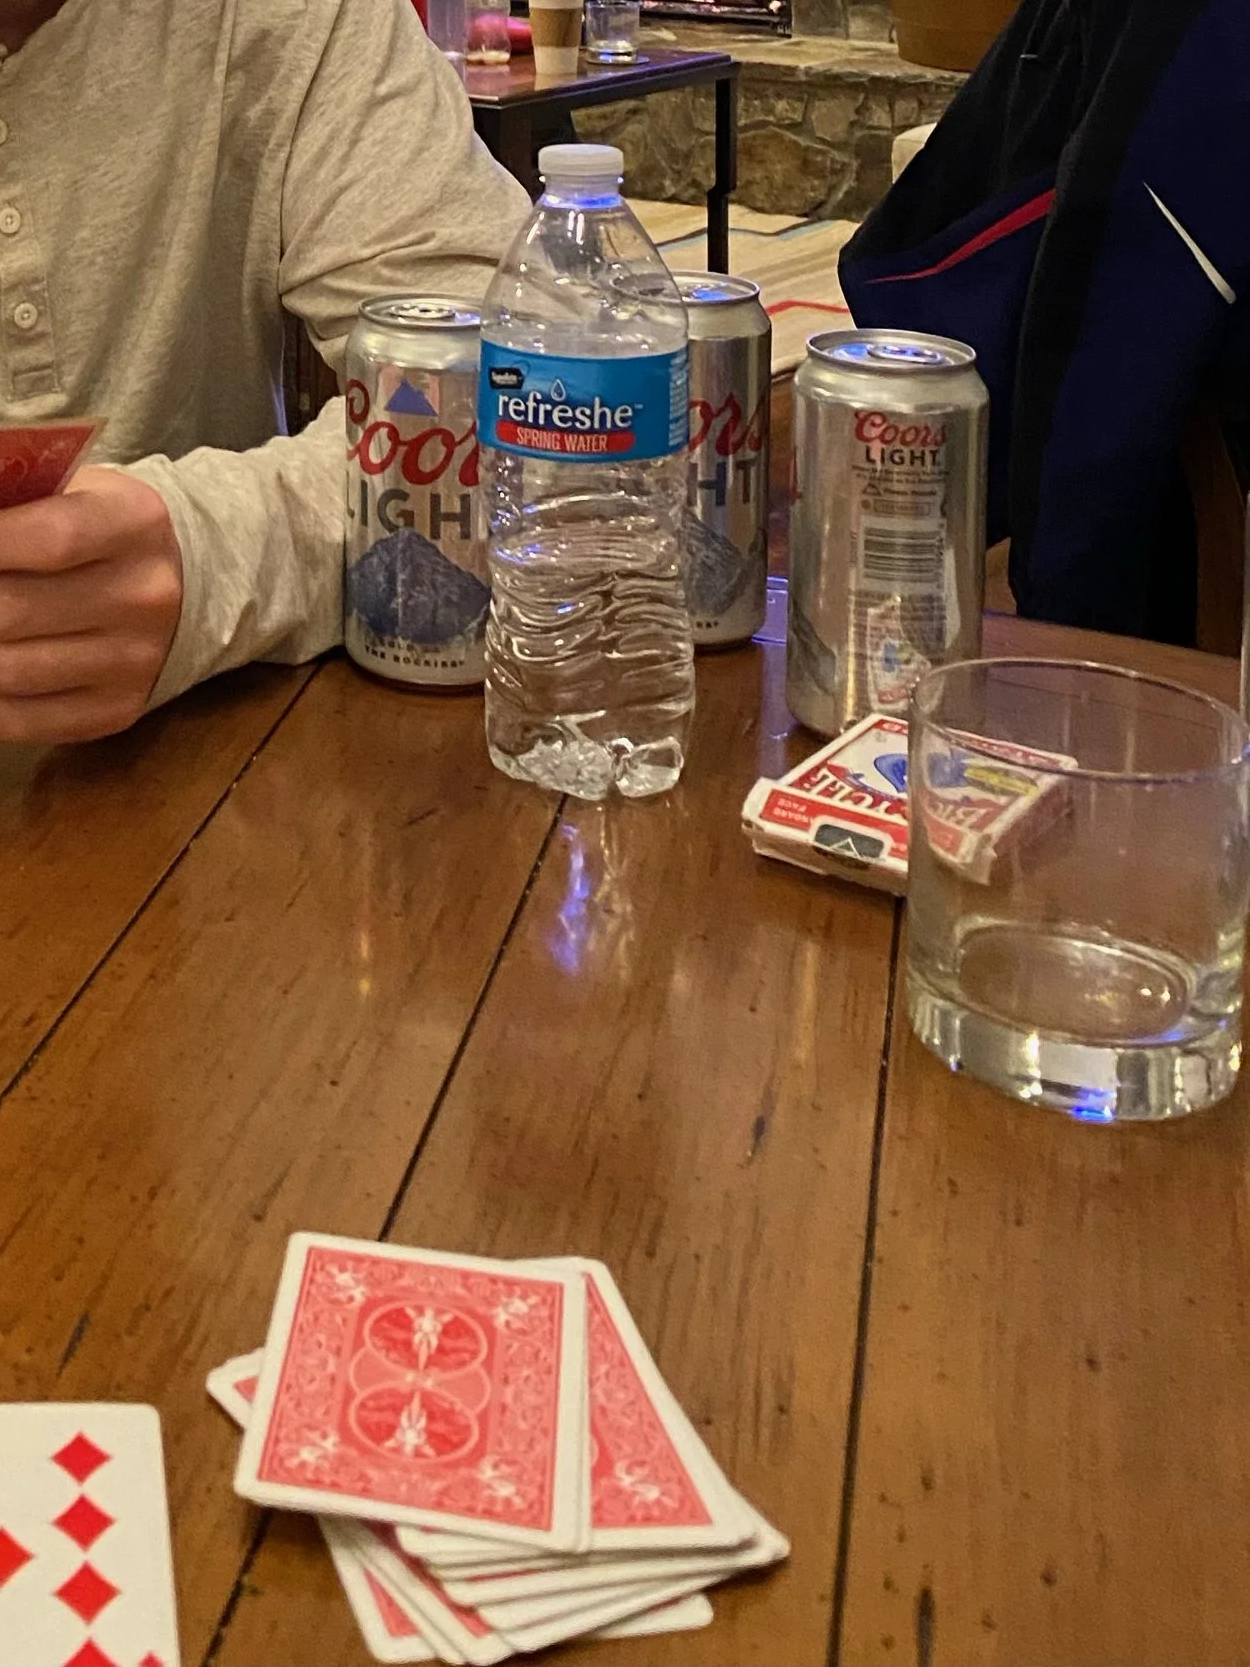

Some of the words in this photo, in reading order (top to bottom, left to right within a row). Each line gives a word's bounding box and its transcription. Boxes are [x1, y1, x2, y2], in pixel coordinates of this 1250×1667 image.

[498, 391, 634, 430] refreshe
[516, 427, 561, 451] SPRING
[563, 432, 608, 452] WATER
[854, 410, 947, 447] Coors
[865, 445, 939, 467] LIGHT
